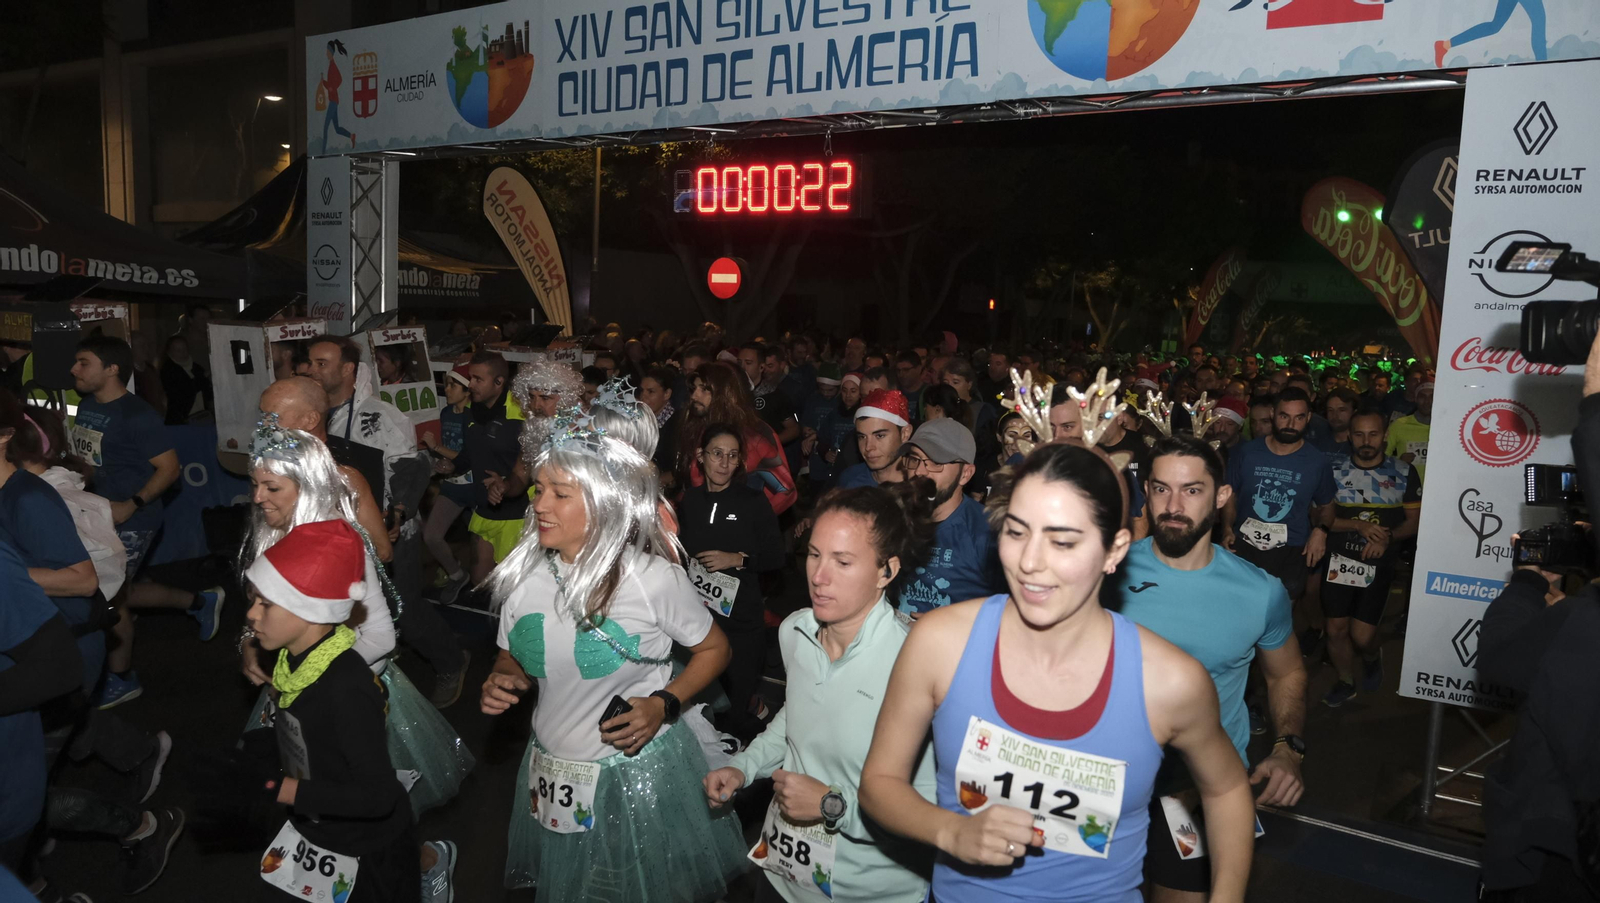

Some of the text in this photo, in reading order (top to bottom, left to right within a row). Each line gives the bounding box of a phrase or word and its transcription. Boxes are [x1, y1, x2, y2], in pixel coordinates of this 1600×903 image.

[554, 10, 613, 63] XIV
[624, 0, 701, 55] SAN
[557, 13, 979, 118] CIUDAD DE ALMERÍA
[384, 70, 437, 93] ALMERÍA
[397, 90, 424, 103] CIUDAD
[1475, 168, 1586, 182] RENAULT
[697, 162, 852, 212] 00:00:22
[1474, 184, 1583, 195] SYRSA AUTOMOCION
[312, 211, 343, 220] RENAULT
[382, 329, 417, 342] Surbús
[76, 438, 93, 452] 106
[1253, 530, 1271, 542] 34
[1339, 563, 1365, 576] 840
[693, 575, 722, 599] 240
[1415, 686, 1446, 699] SYRSA
[997, 747, 1042, 773] CIUDAD
[1043, 763, 1061, 779] DE
[1000, 733, 1116, 777] XIV SAN SILVESTRE
[538, 776, 574, 807] 813
[993, 771, 1080, 821] 112
[769, 825, 811, 866] 258
[292, 839, 337, 877] 956
